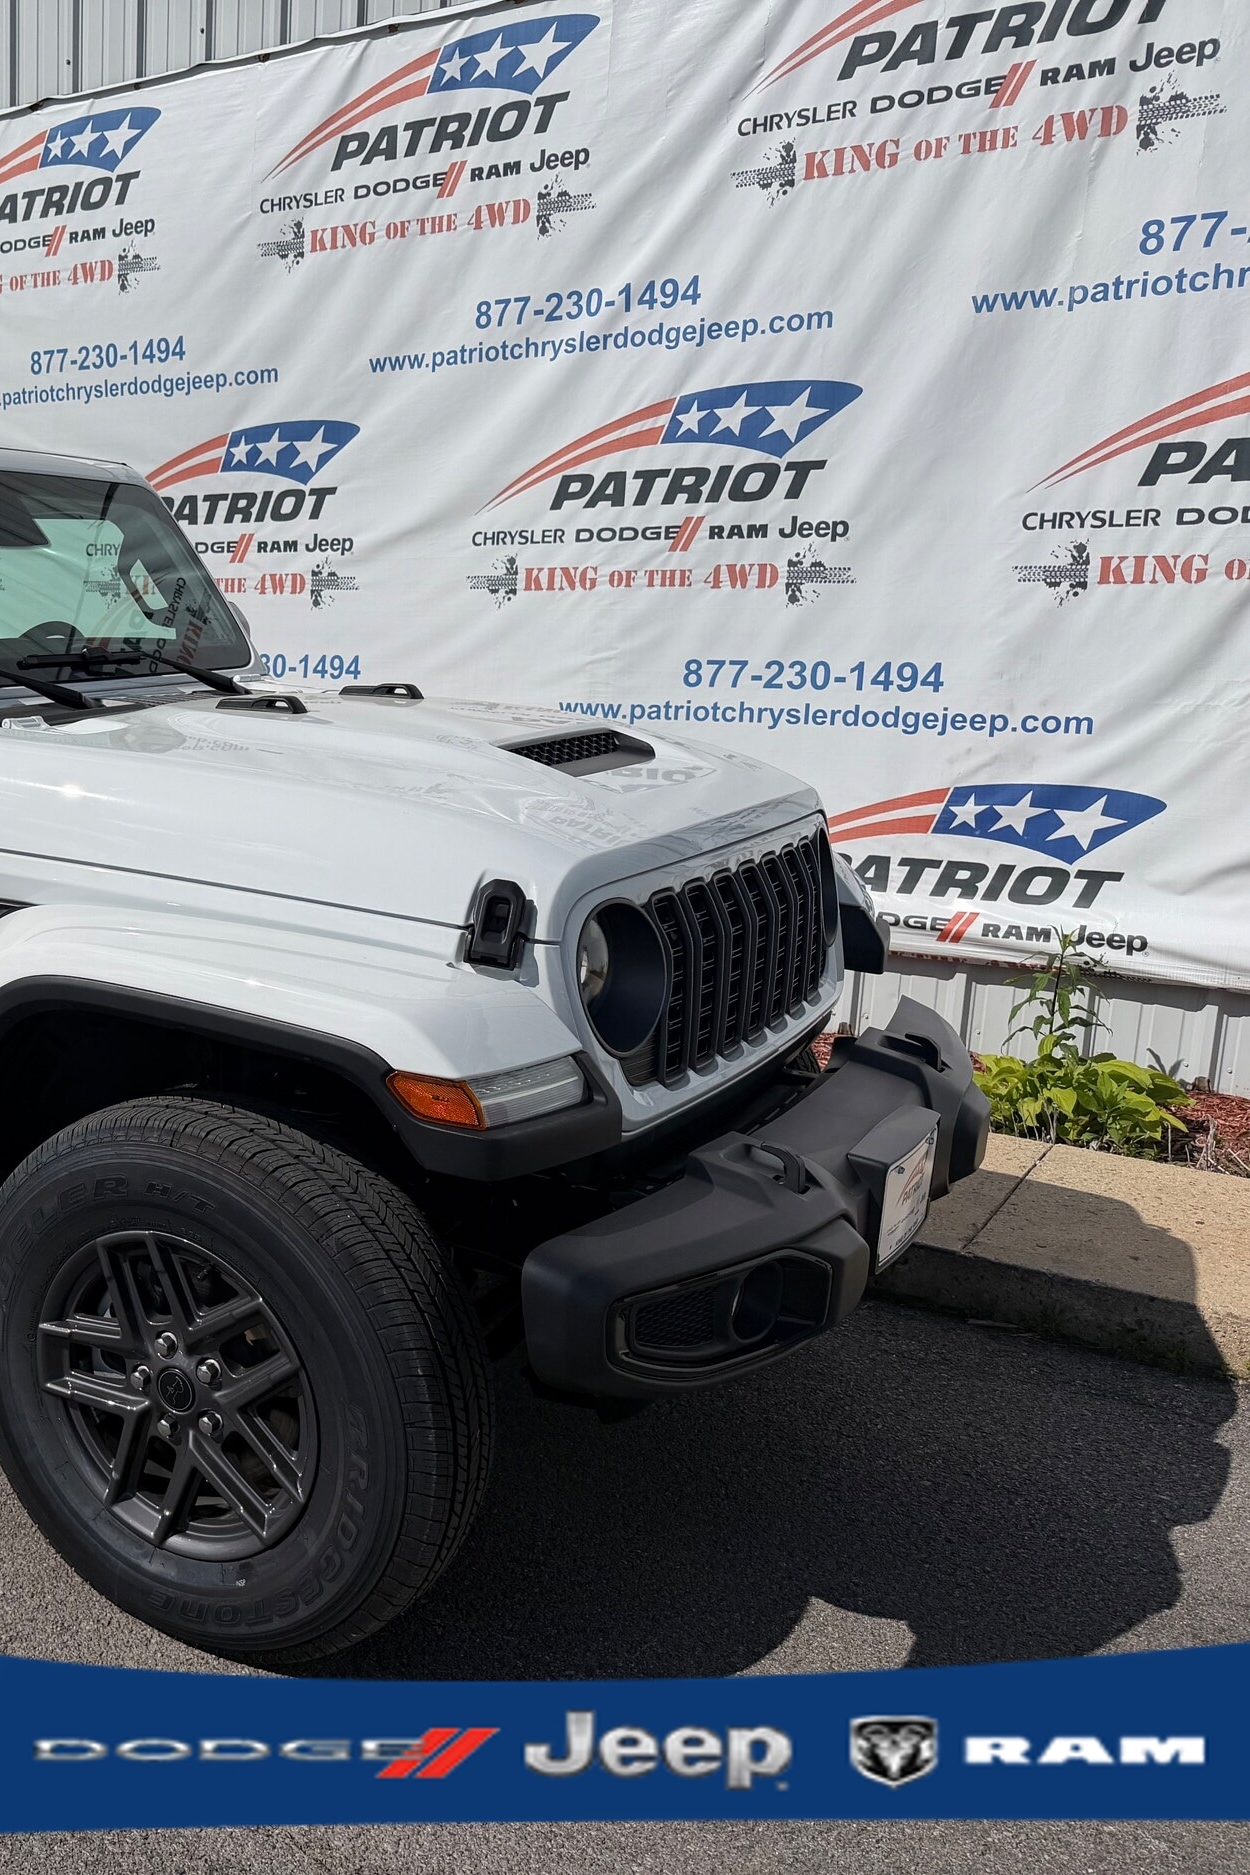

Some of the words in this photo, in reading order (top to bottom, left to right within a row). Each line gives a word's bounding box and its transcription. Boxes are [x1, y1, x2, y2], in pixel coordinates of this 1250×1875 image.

[737, 101, 857, 137] CHRYSLER
[870, 75, 1006, 115] DODGE
[1040, 58, 1116, 87] RAM
[1129, 37, 1221, 72] Jeep
[330, 90, 571, 172] PATRIOT
[803, 139, 900, 181] KING
[914, 136, 950, 162] OF
[958, 126, 1018, 155] THE
[1032, 105, 1129, 147] 4WD
[260, 188, 345, 214] CHRYSLER
[353, 172, 449, 200] DODGE
[469, 160, 521, 182] RAM
[530, 147, 590, 172] Jeep
[69, 227, 106, 244] RAM
[112, 218, 155, 238] Jeep
[309, 221, 376, 253] KING
[385, 220, 411, 240] OF
[416, 213, 458, 236] THE
[467, 198, 531, 230] 4WD
[9, 274, 27, 292] OF
[30, 270, 61, 289] THE
[67, 259, 114, 285] 4WD
[475, 275, 702, 329] 877-230-1494
[30, 335, 186, 375] 877-230-1494
[369, 310, 834, 373] www.patriotchryslerdodgejeep.com
[549, 459, 827, 511] PATRIOT
[471, 528, 565, 547] CHRYSLER
[575, 525, 682, 543] DODGE
[708, 523, 768, 540] RAM
[778, 516, 849, 543] Jeep
[1022, 508, 1161, 531] CHRYSLER
[257, 540, 298, 553] RAM
[305, 534, 354, 556] Jeep
[254, 573, 306, 595] 4WD
[523, 566, 598, 592] KING
[609, 570, 637, 588] OF
[644, 568, 692, 587] THE
[703, 563, 779, 590] 4WD
[1097, 555, 1209, 585] KING
[683, 658, 944, 693] 877-230-1494
[558, 698, 1094, 736] www.patriotchryslerdodgejeep.com
[981, 922, 1051, 943] RAM
[1072, 924, 1148, 956] Jeep
